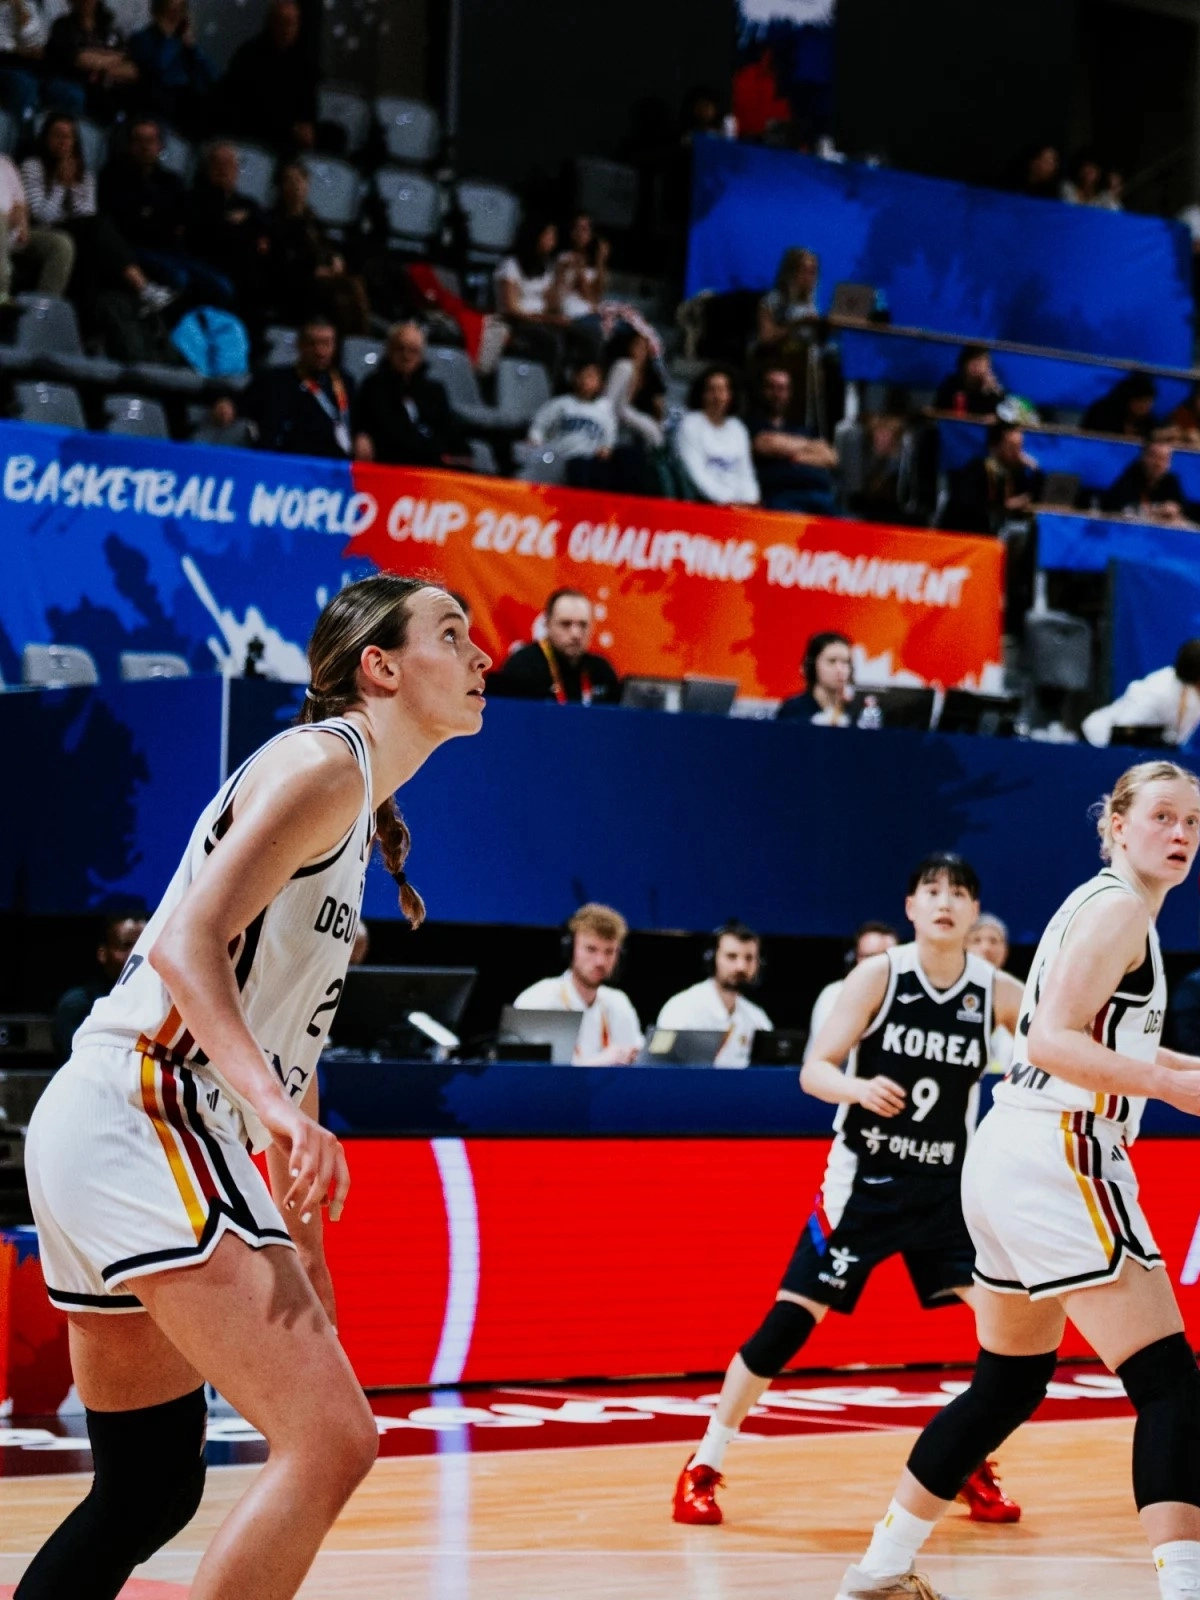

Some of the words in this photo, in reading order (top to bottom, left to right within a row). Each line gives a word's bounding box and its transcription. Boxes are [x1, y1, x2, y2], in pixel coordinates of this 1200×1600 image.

[3, 456, 234, 523] BASKETBALL
[249, 484, 377, 537] WORLD
[388, 496, 463, 545] CUP
[472, 509, 561, 558] 2026
[569, 522, 755, 582] QUALIFYING
[765, 543, 970, 608] TOURNAMENT
[882, 1021, 981, 1068] KOREA
[911, 1077, 940, 1123] 9
